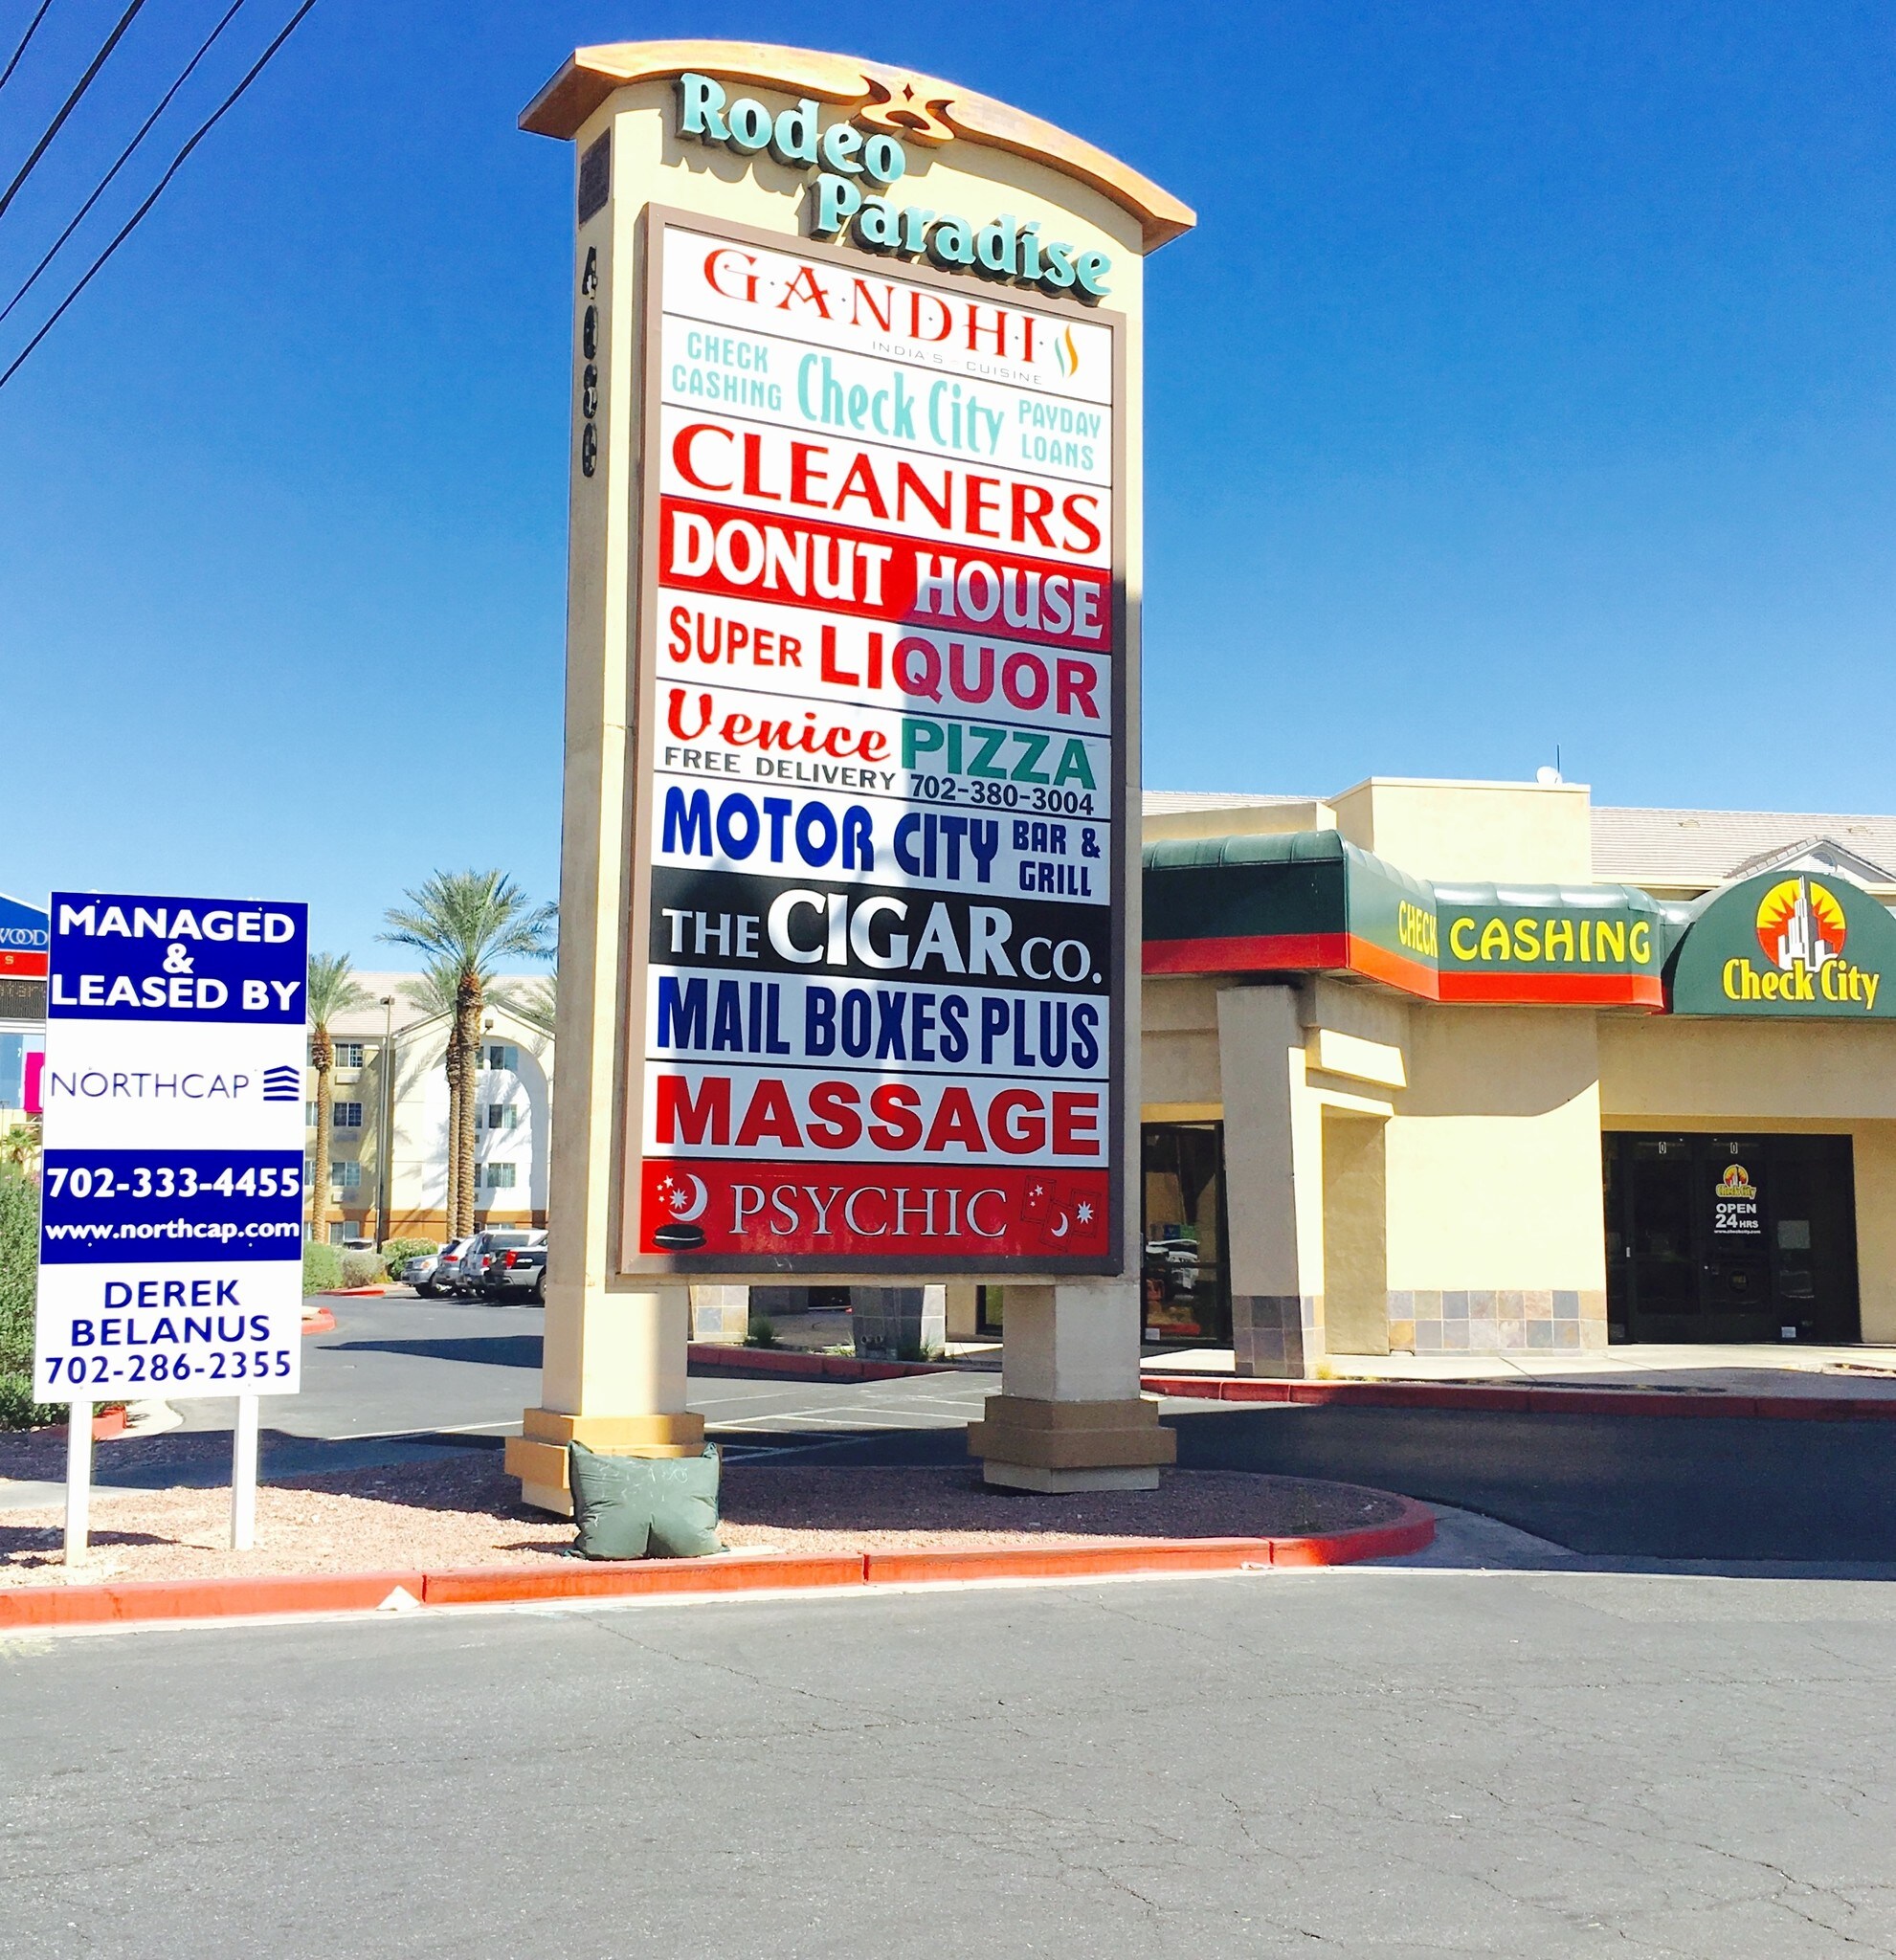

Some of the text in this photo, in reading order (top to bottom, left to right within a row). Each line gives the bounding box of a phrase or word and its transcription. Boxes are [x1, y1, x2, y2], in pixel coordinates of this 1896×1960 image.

[677, 72, 906, 186] Rodeo
[814, 173, 1113, 299] Paradise
[687, 331, 769, 373] CHECK
[872, 341, 1042, 386] INDIA'S CUISINE
[672, 365, 782, 412] CASHING
[797, 353, 1005, 456] Check City
[1019, 399, 1102, 439] PAYDAY
[1021, 434, 1095, 471] LOANS
[672, 423, 1102, 554] CLEANERS
[670, 510, 1104, 639] DONUT HOUSE
[668, 605, 1101, 720] SUPER LIQUOR
[667, 687, 1097, 791] Venice PIZZA
[664, 746, 897, 791] FREE DELIVERY
[910, 773, 1095, 816] 702-380-3004
[661, 786, 999, 883] MOTOR CITY
[1013, 820, 1102, 858] BAR &
[1018, 859, 1092, 897] GRILL
[58, 903, 296, 944] MANAGED
[661, 888, 1103, 984] THE CIGAR CO.
[1398, 900, 1651, 964] CHECK CASHING
[163, 943, 194, 975] &
[51, 974, 229, 1011] LEASED
[241, 980, 301, 1012] BY
[1723, 957, 1880, 1011] Check City
[658, 975, 1100, 1070] MAIL BOXES PLUS
[51, 1071, 250, 1100] NORTHCAP
[656, 1075, 1101, 1156] MASSAGE
[46, 1167, 301, 1198] 702-333-4455
[45, 1217, 300, 1244] www.northcap.com
[728, 1183, 1008, 1237] PSYCHIC
[1715, 1214, 1759, 1229] 24 HRS
[1716, 1203, 1756, 1214] OPEN
[104, 1280, 240, 1309] DEREK
[71, 1316, 270, 1348] BELANUS
[45, 1351, 291, 1385] 702-286-2355
